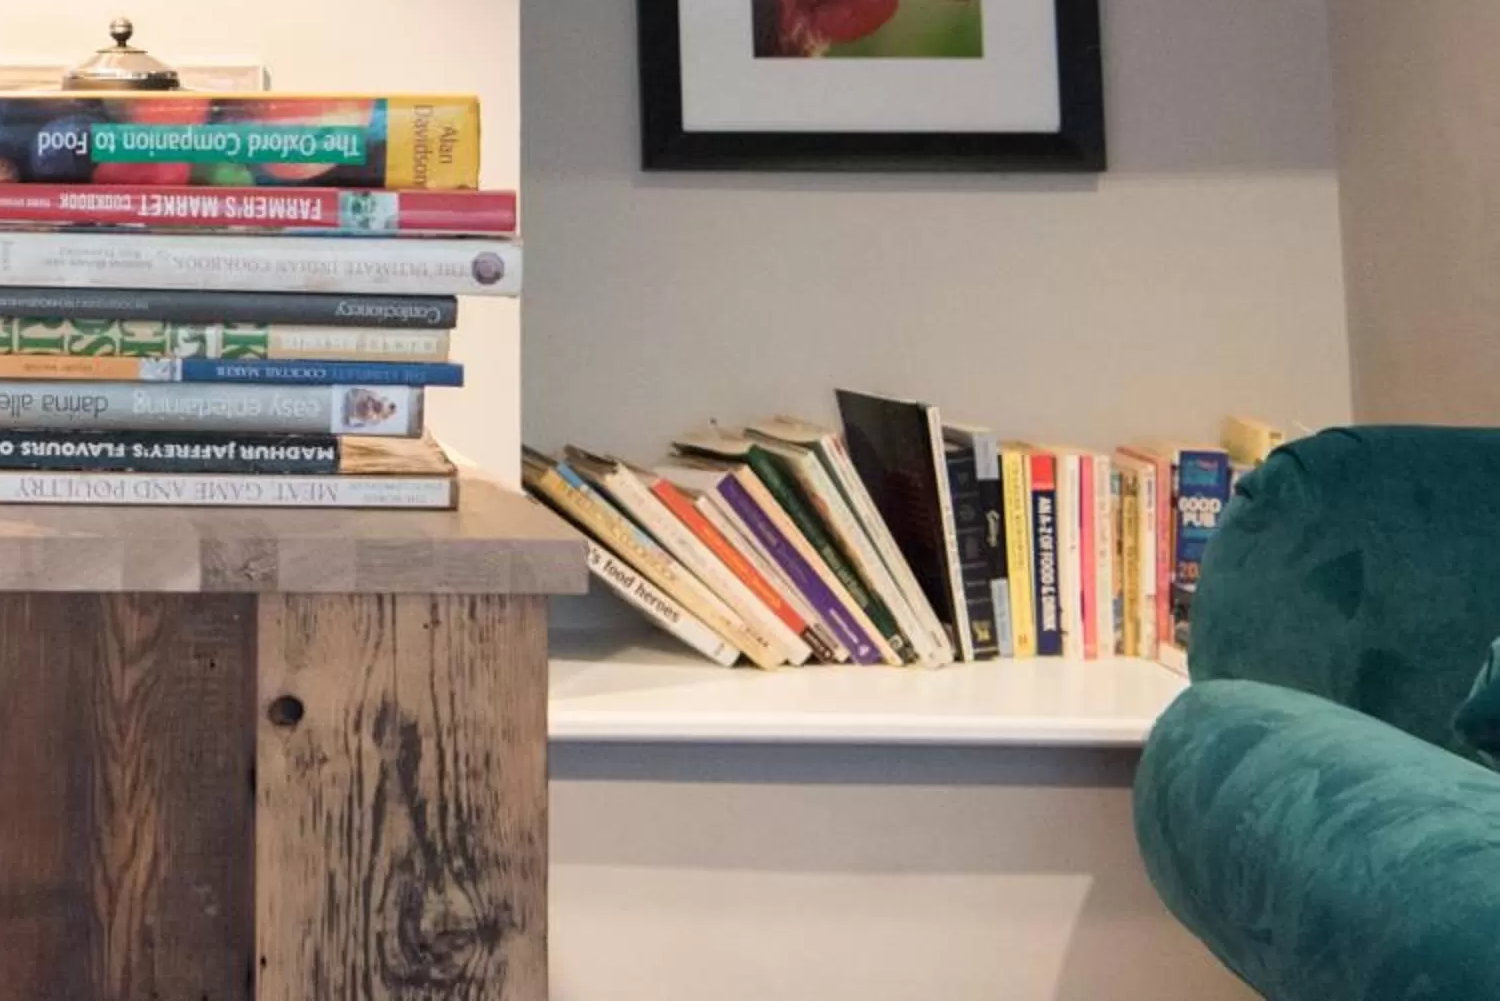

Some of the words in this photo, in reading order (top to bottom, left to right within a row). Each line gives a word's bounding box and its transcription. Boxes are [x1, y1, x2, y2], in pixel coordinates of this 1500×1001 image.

[37, 130, 88, 156] Food
[94, 131, 116, 153] to
[122, 125, 241, 157] Companion
[249, 133, 317, 157] Oxford
[323, 133, 361, 157] The
[412, 104, 434, 187] Davidson
[438, 125, 458, 165] Alan
[59, 193, 132, 211] COOKBOOK
[138, 194, 220, 218] MARKET
[224, 196, 323, 220] FARMER'S
[335, 301, 442, 324] Confectionery
[132, 390, 263, 418] entertaining
[268, 392, 323, 418] easy
[20, 439, 126, 458] FLAVOURS
[240, 445, 335, 461] MADHUR
[19, 477, 126, 499] POULTRY
[133, 479, 186, 500] AND
[196, 480, 263, 501] GAME
[1179, 497, 1222, 513] GOOD
[603, 559, 636, 589] food
[634, 582, 681, 624] heroes
